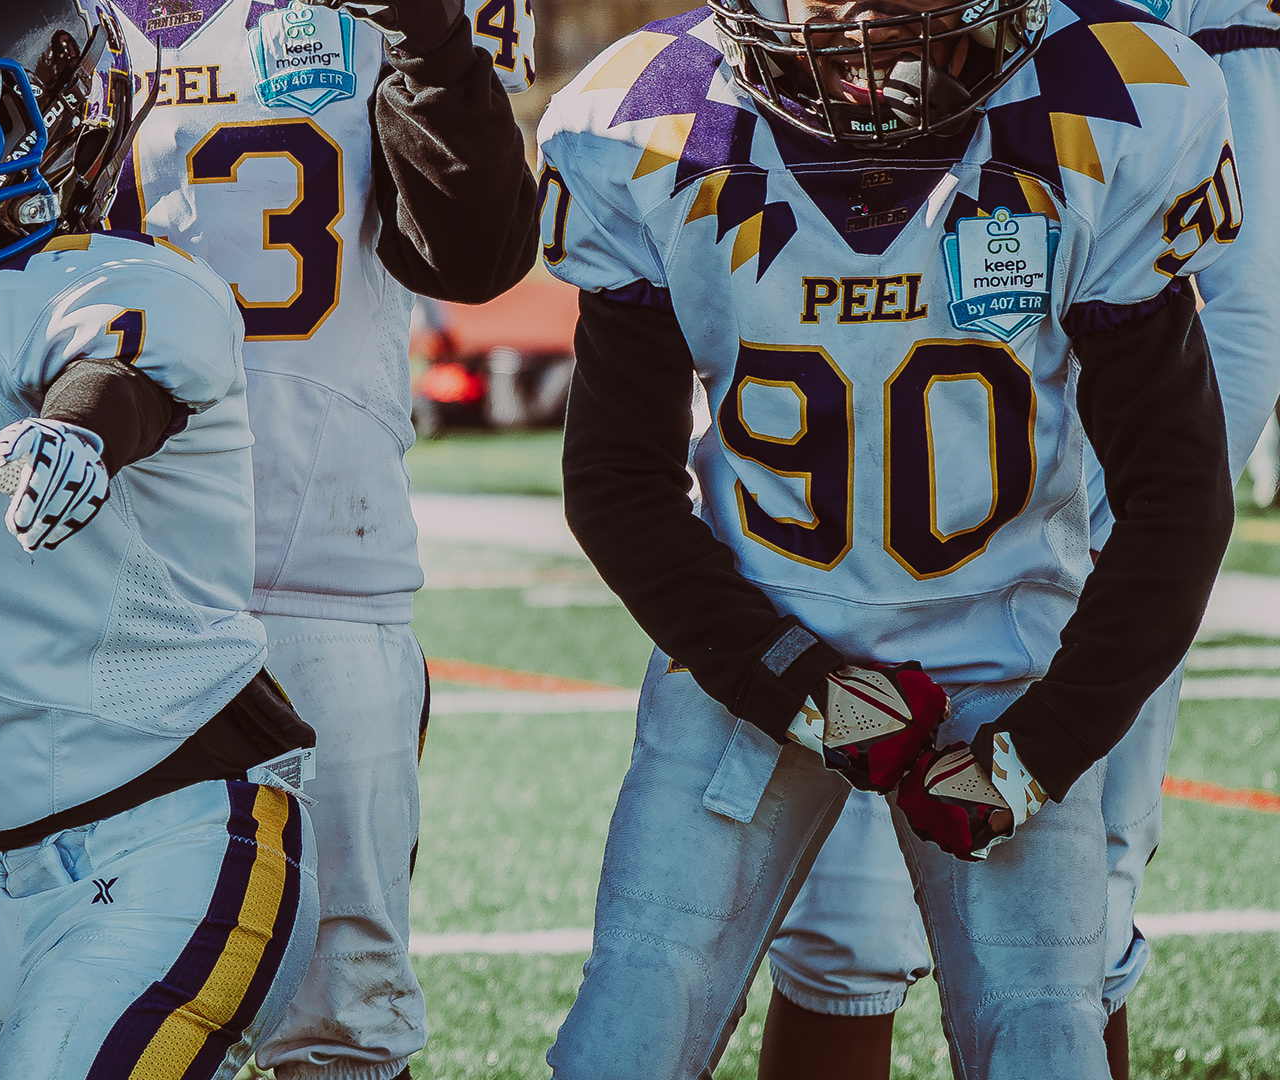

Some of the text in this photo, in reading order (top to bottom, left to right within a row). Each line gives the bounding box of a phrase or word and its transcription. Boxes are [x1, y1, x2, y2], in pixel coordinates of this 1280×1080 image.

[285, 41, 323, 55] keep
[271, 73, 344, 92] by 407 ETR
[984, 258, 1027, 273] keep
[801, 273, 928, 324] PEEL
[966, 296, 1042, 315] by 407 ETR
[106, 308, 146, 355] 1
[718, 335, 1037, 581] 90
